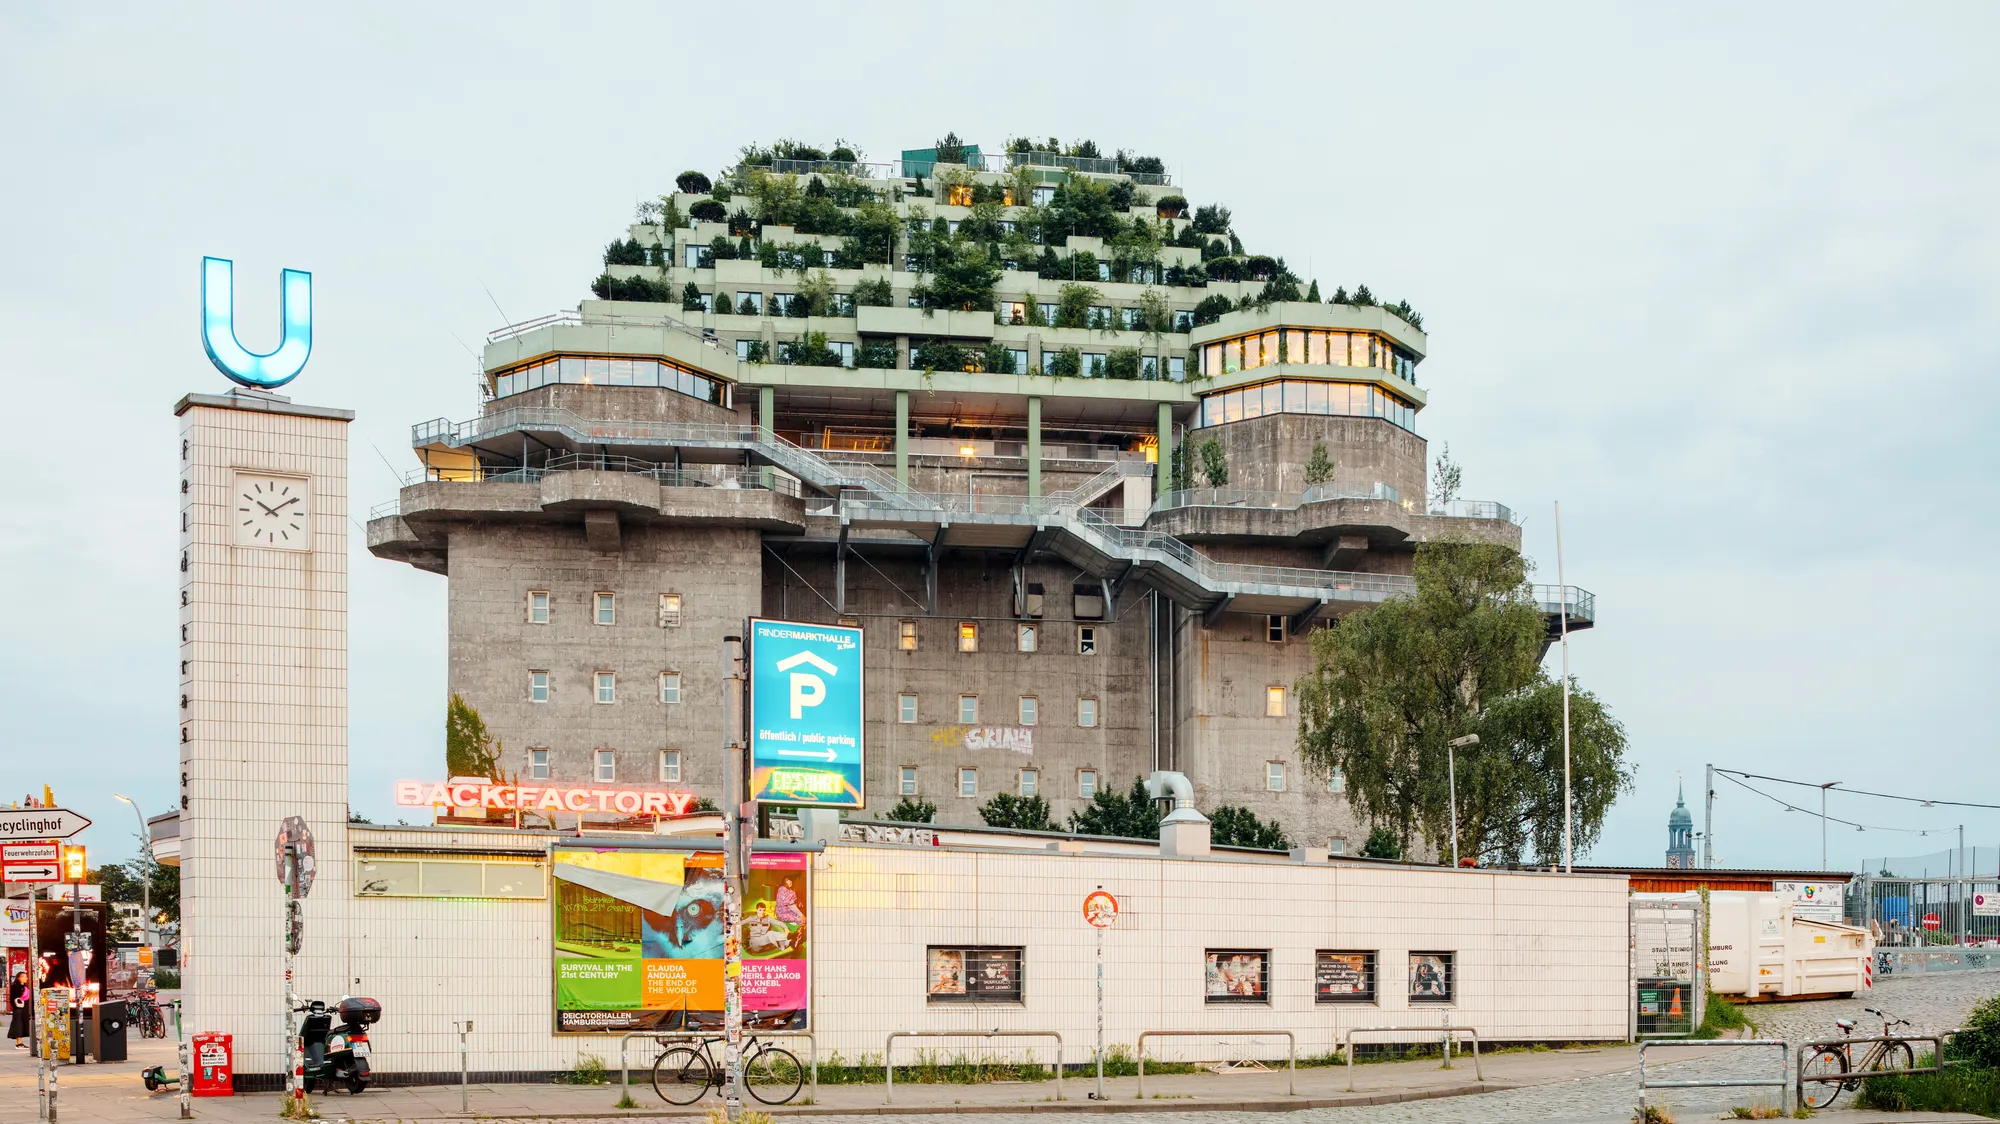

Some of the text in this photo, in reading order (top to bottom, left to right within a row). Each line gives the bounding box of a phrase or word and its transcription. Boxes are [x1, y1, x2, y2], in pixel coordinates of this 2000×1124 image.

[201, 256, 312, 389] U
[758, 627, 851, 644] RINDERMARKTHALLE
[790, 672, 826, 719] P
[759, 729, 796, 741] öffentlich
[802, 732, 825, 744] public
[827, 734, 855, 747] parking
[4, 849, 55, 857] Feuerwehrzufahrt
[562, 1018, 602, 1026] HAMBURG
